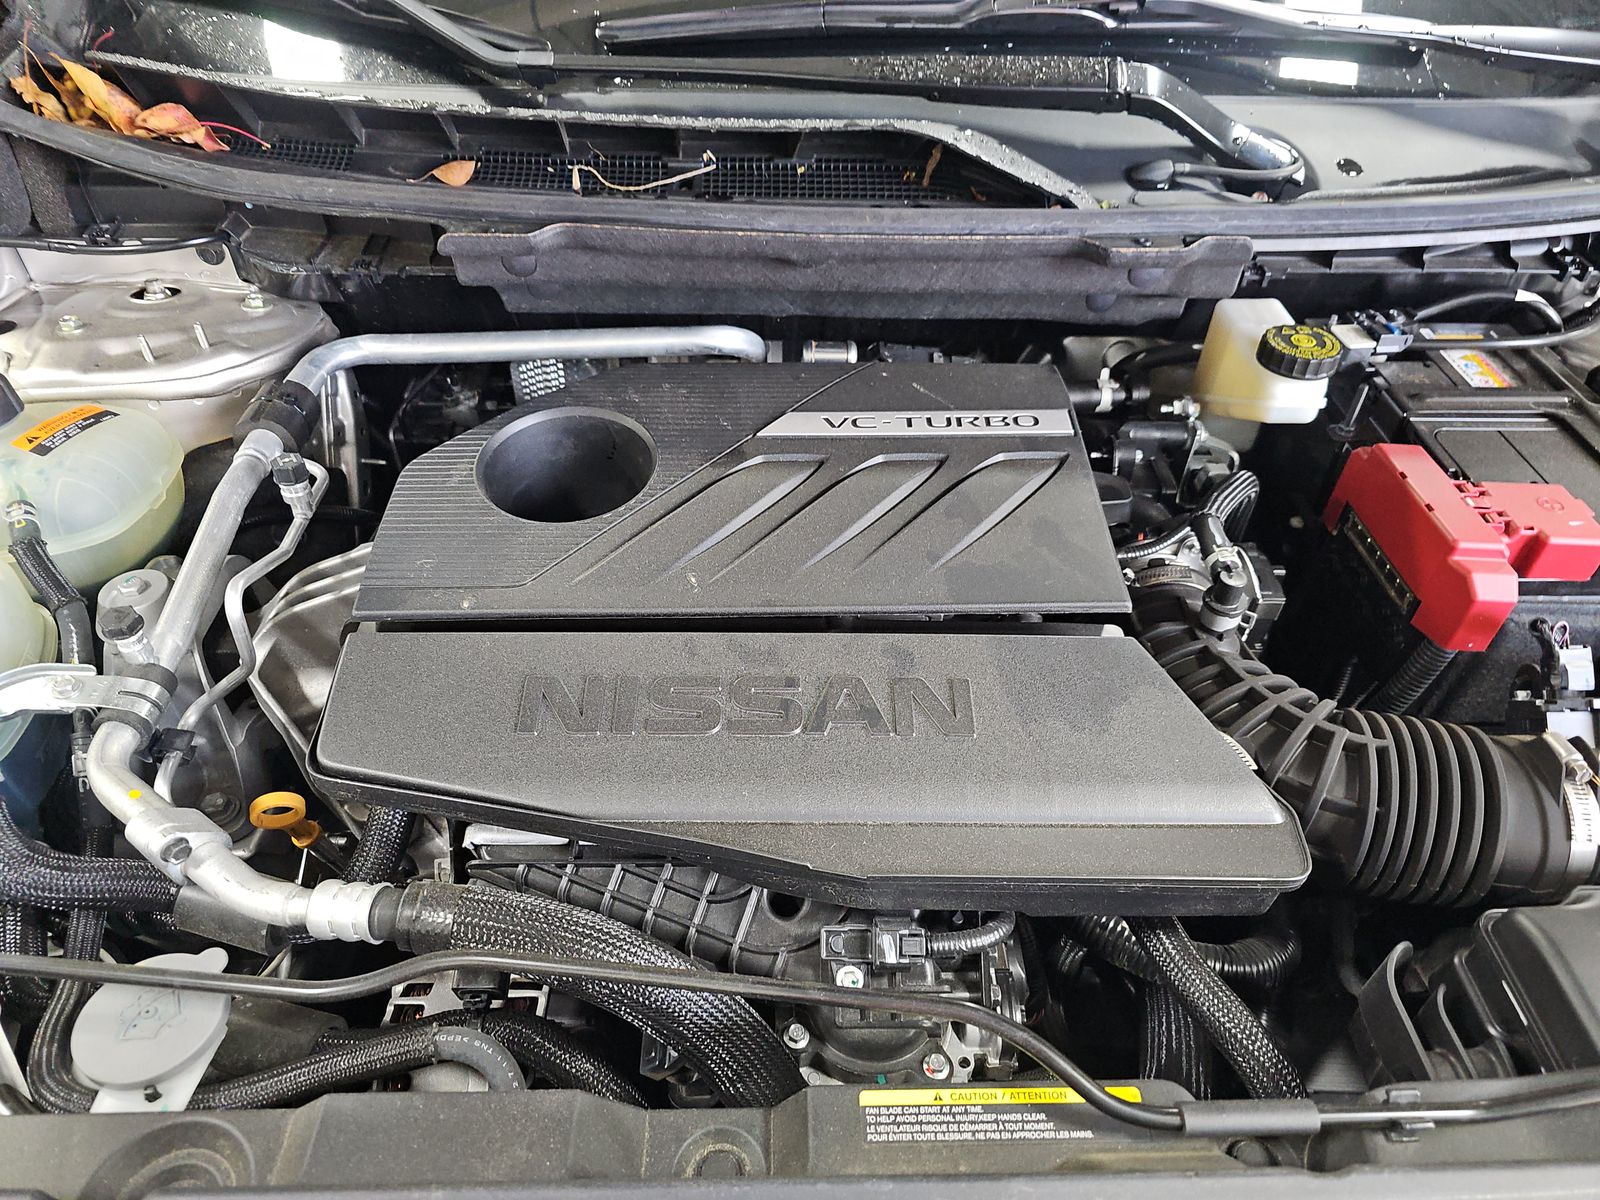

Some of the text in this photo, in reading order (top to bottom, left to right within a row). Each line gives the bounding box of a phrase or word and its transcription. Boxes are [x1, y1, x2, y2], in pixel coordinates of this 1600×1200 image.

[820, 414, 1040, 429] VC-TURBO
[276, 453, 297, 466] H
[515, 675, 977, 737] NISSAN
[950, 1092, 998, 1101] CAUTION
[1009, 1091, 1067, 1100] ATTENTION
[865, 1106, 880, 1115] FAN
[880, 1106, 903, 1115] BLADE
[903, 1106, 919, 1114] CAN
[919, 1106, 942, 1114] START
[941, 1105, 951, 1114] AT
[951, 1105, 966, 1113] ANY
[865, 1115, 877, 1123] TO
[877, 1115, 896, 1123] HELP
[895, 1114, 918, 1123] AVOID
[917, 1114, 956, 1122] PERSONAL
[997, 1113, 1022, 1121] HANDS
[1022, 1112, 1048, 1121] CLEAR.
[866, 1124, 876, 1133] LE
[876, 1124, 921, 1133] VENTILATEUR
[921, 1123, 949, 1132] RISQUE
[948, 1123, 960, 1132] DE
[959, 1121, 998, 1131] DÉMARRER
[1004, 1122, 1023, 1131] TOUT
[1023, 1122, 1056, 1130] MOMENT.
[867, 1133, 888, 1142] POUR
[913, 1133, 936, 1141] TOUTE
[975, 1132, 986, 1140] NE
[985, 1132, 1001, 1140] PAS
[1000, 1131, 1012, 1140] EN
[1012, 1131, 1056, 1139] APPROCHER
[1056, 1130, 1070, 1139] LES
